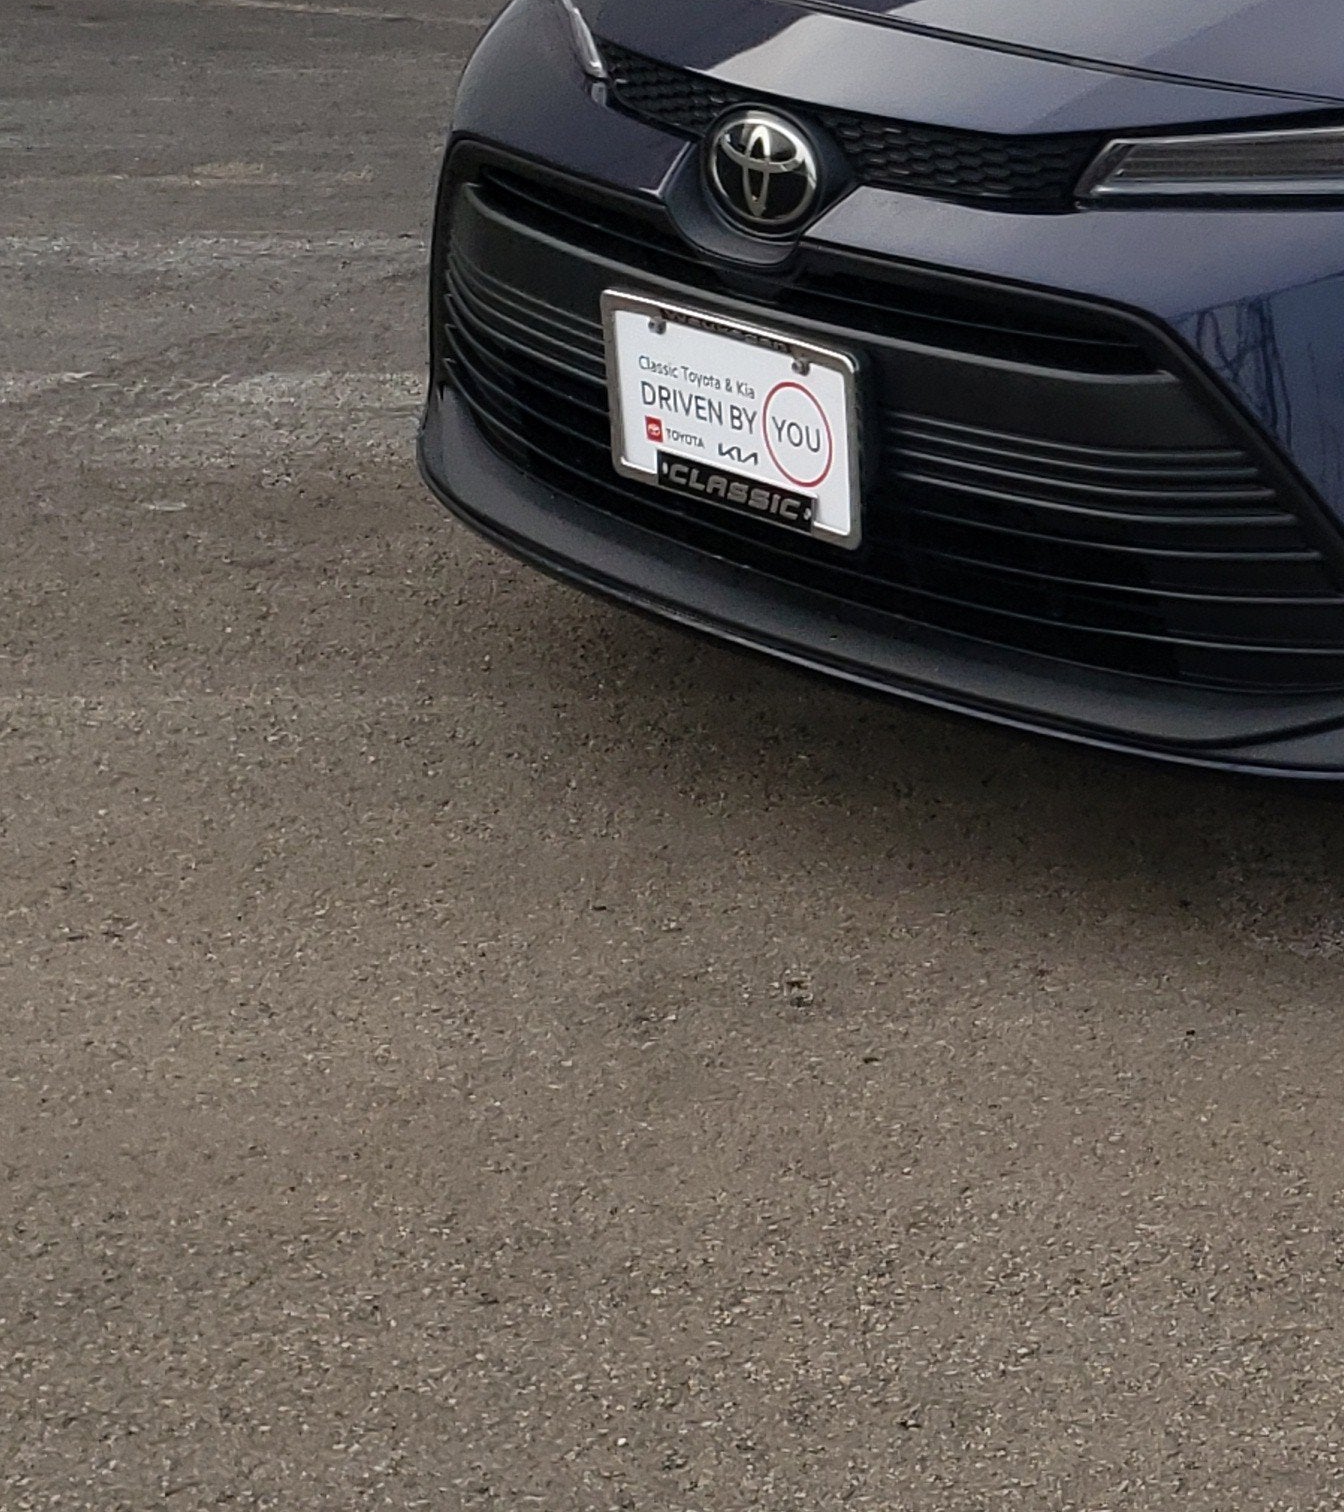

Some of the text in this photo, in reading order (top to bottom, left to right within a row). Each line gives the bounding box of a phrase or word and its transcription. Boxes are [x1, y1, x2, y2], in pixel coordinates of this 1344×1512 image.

[638, 354, 755, 400] Classic Toyota & Kia
[641, 380, 821, 453] DRIVEN BY YOU
[666, 428, 705, 449] TOYOTA
[669, 463, 801, 520] CLASSIC
